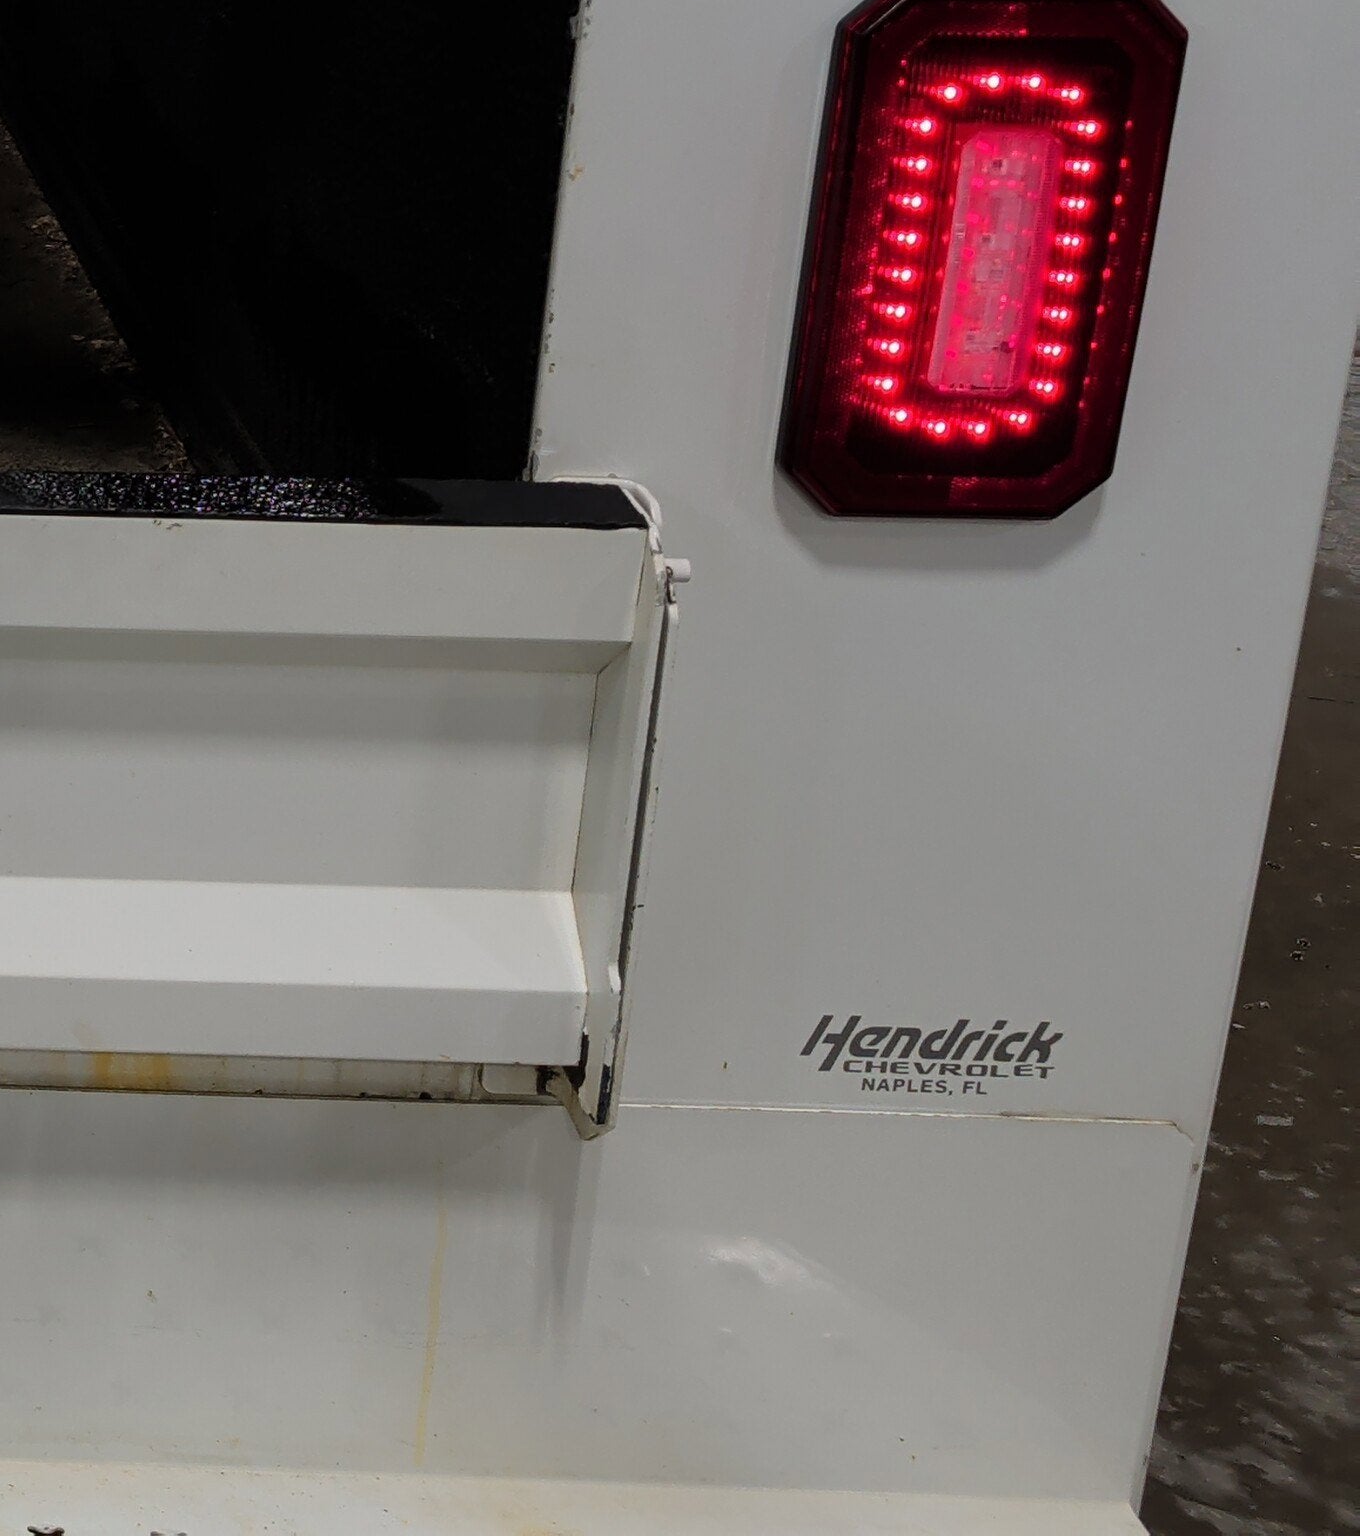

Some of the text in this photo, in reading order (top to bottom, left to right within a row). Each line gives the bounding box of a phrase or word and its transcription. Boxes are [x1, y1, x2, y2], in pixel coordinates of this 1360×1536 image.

[799, 1014, 1064, 1072] Hendrick
[842, 1060, 1056, 1079] CHEVROLET
[861, 1077, 988, 1097] NAPLES, FL
